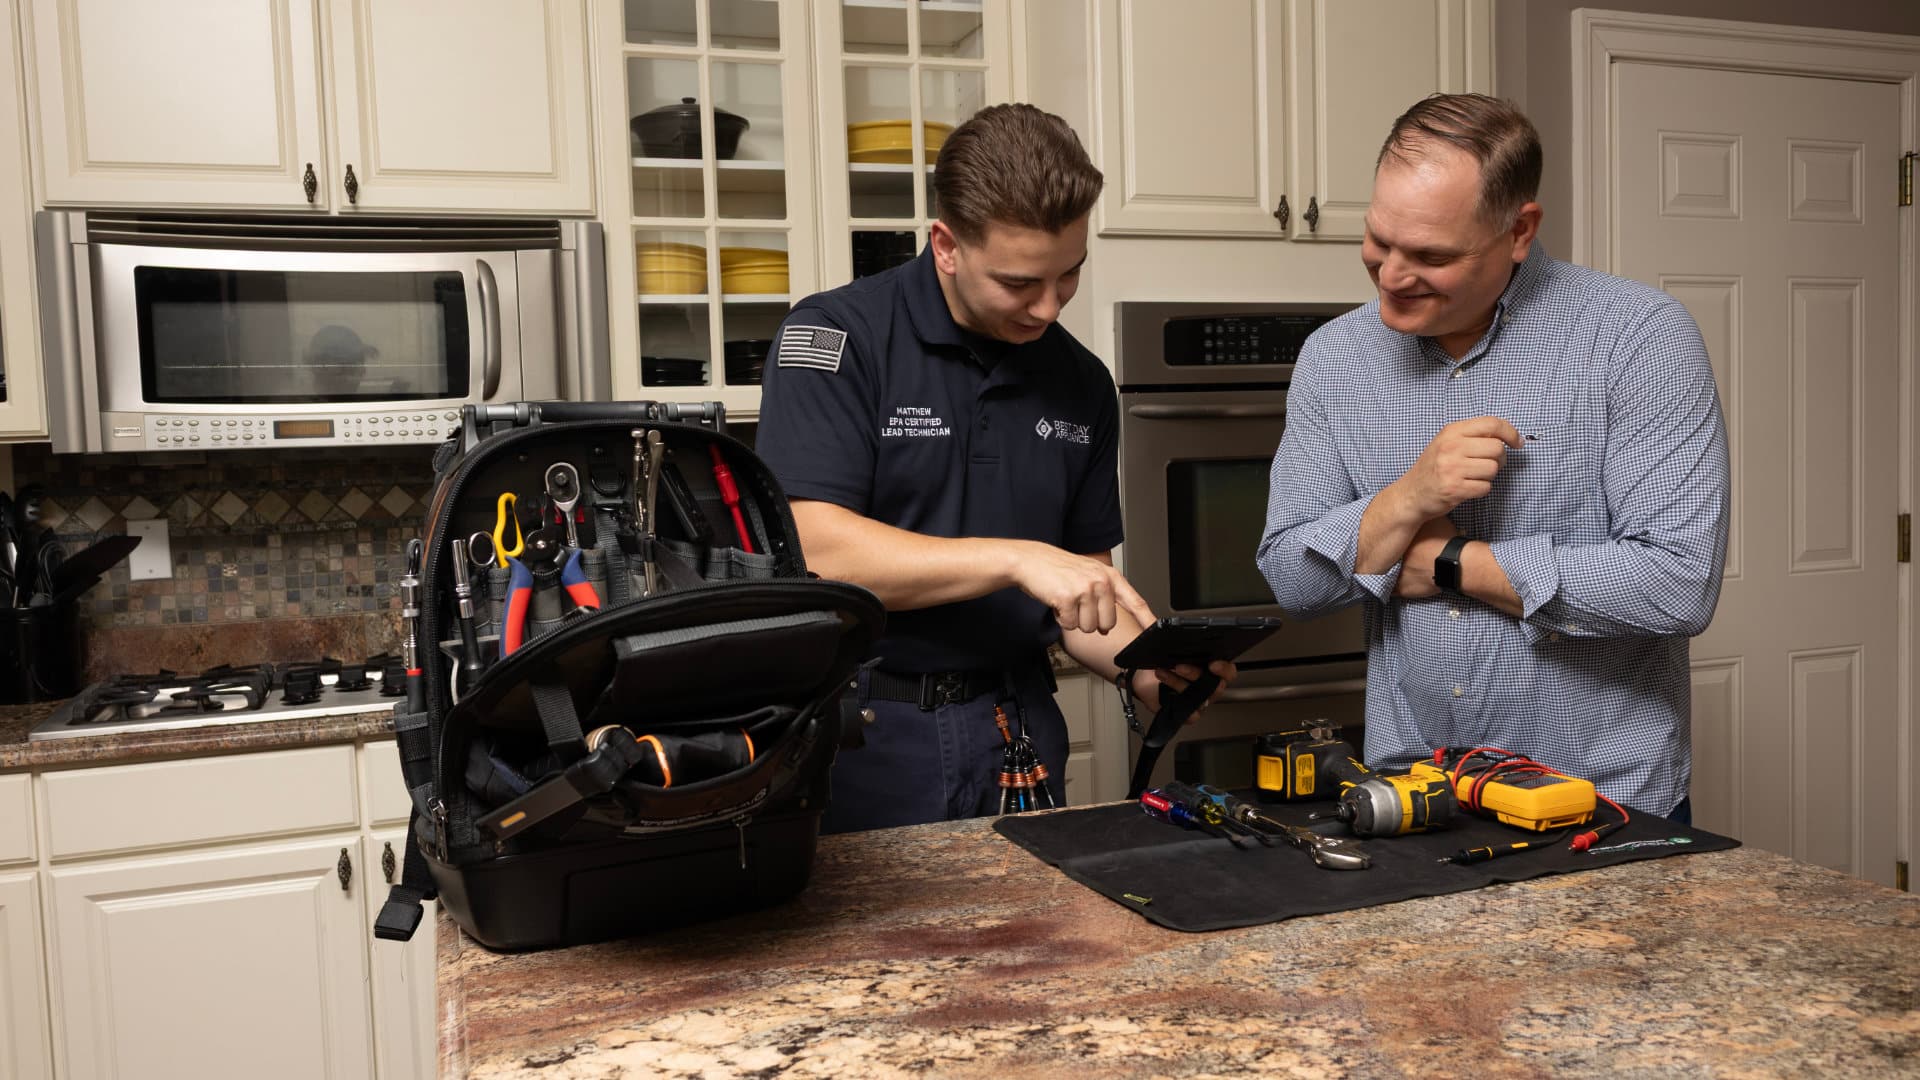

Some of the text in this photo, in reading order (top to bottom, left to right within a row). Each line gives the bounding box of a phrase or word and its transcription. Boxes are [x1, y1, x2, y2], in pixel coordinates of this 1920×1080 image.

[896, 407, 931, 416] MATTHEW
[889, 417, 942, 426] EPA CERTIFIED
[881, 426, 951, 437] LEAD TECHNICIAN
[1053, 420, 1090, 436] BEST DAY
